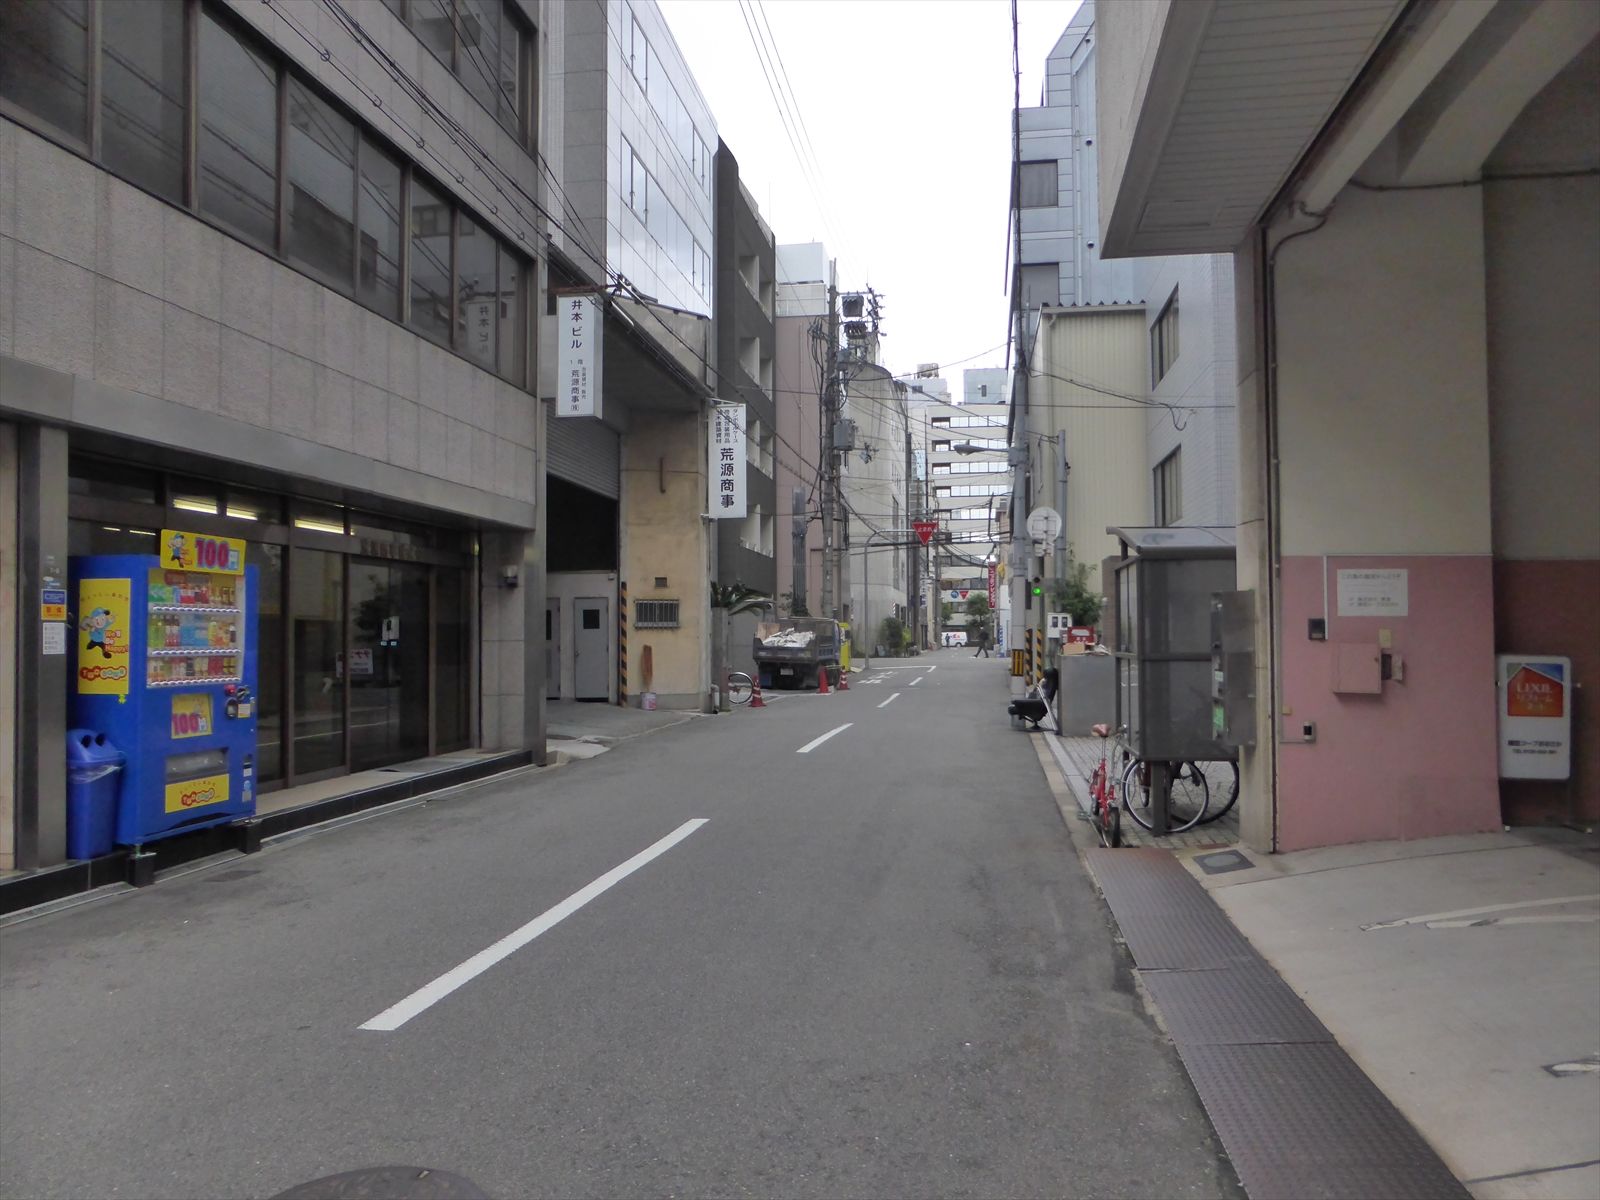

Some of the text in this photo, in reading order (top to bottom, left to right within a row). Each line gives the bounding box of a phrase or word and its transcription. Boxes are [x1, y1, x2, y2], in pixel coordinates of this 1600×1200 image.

[570, 299, 583, 349] 井本ビル
[720, 447, 735, 508] 荒源商事
